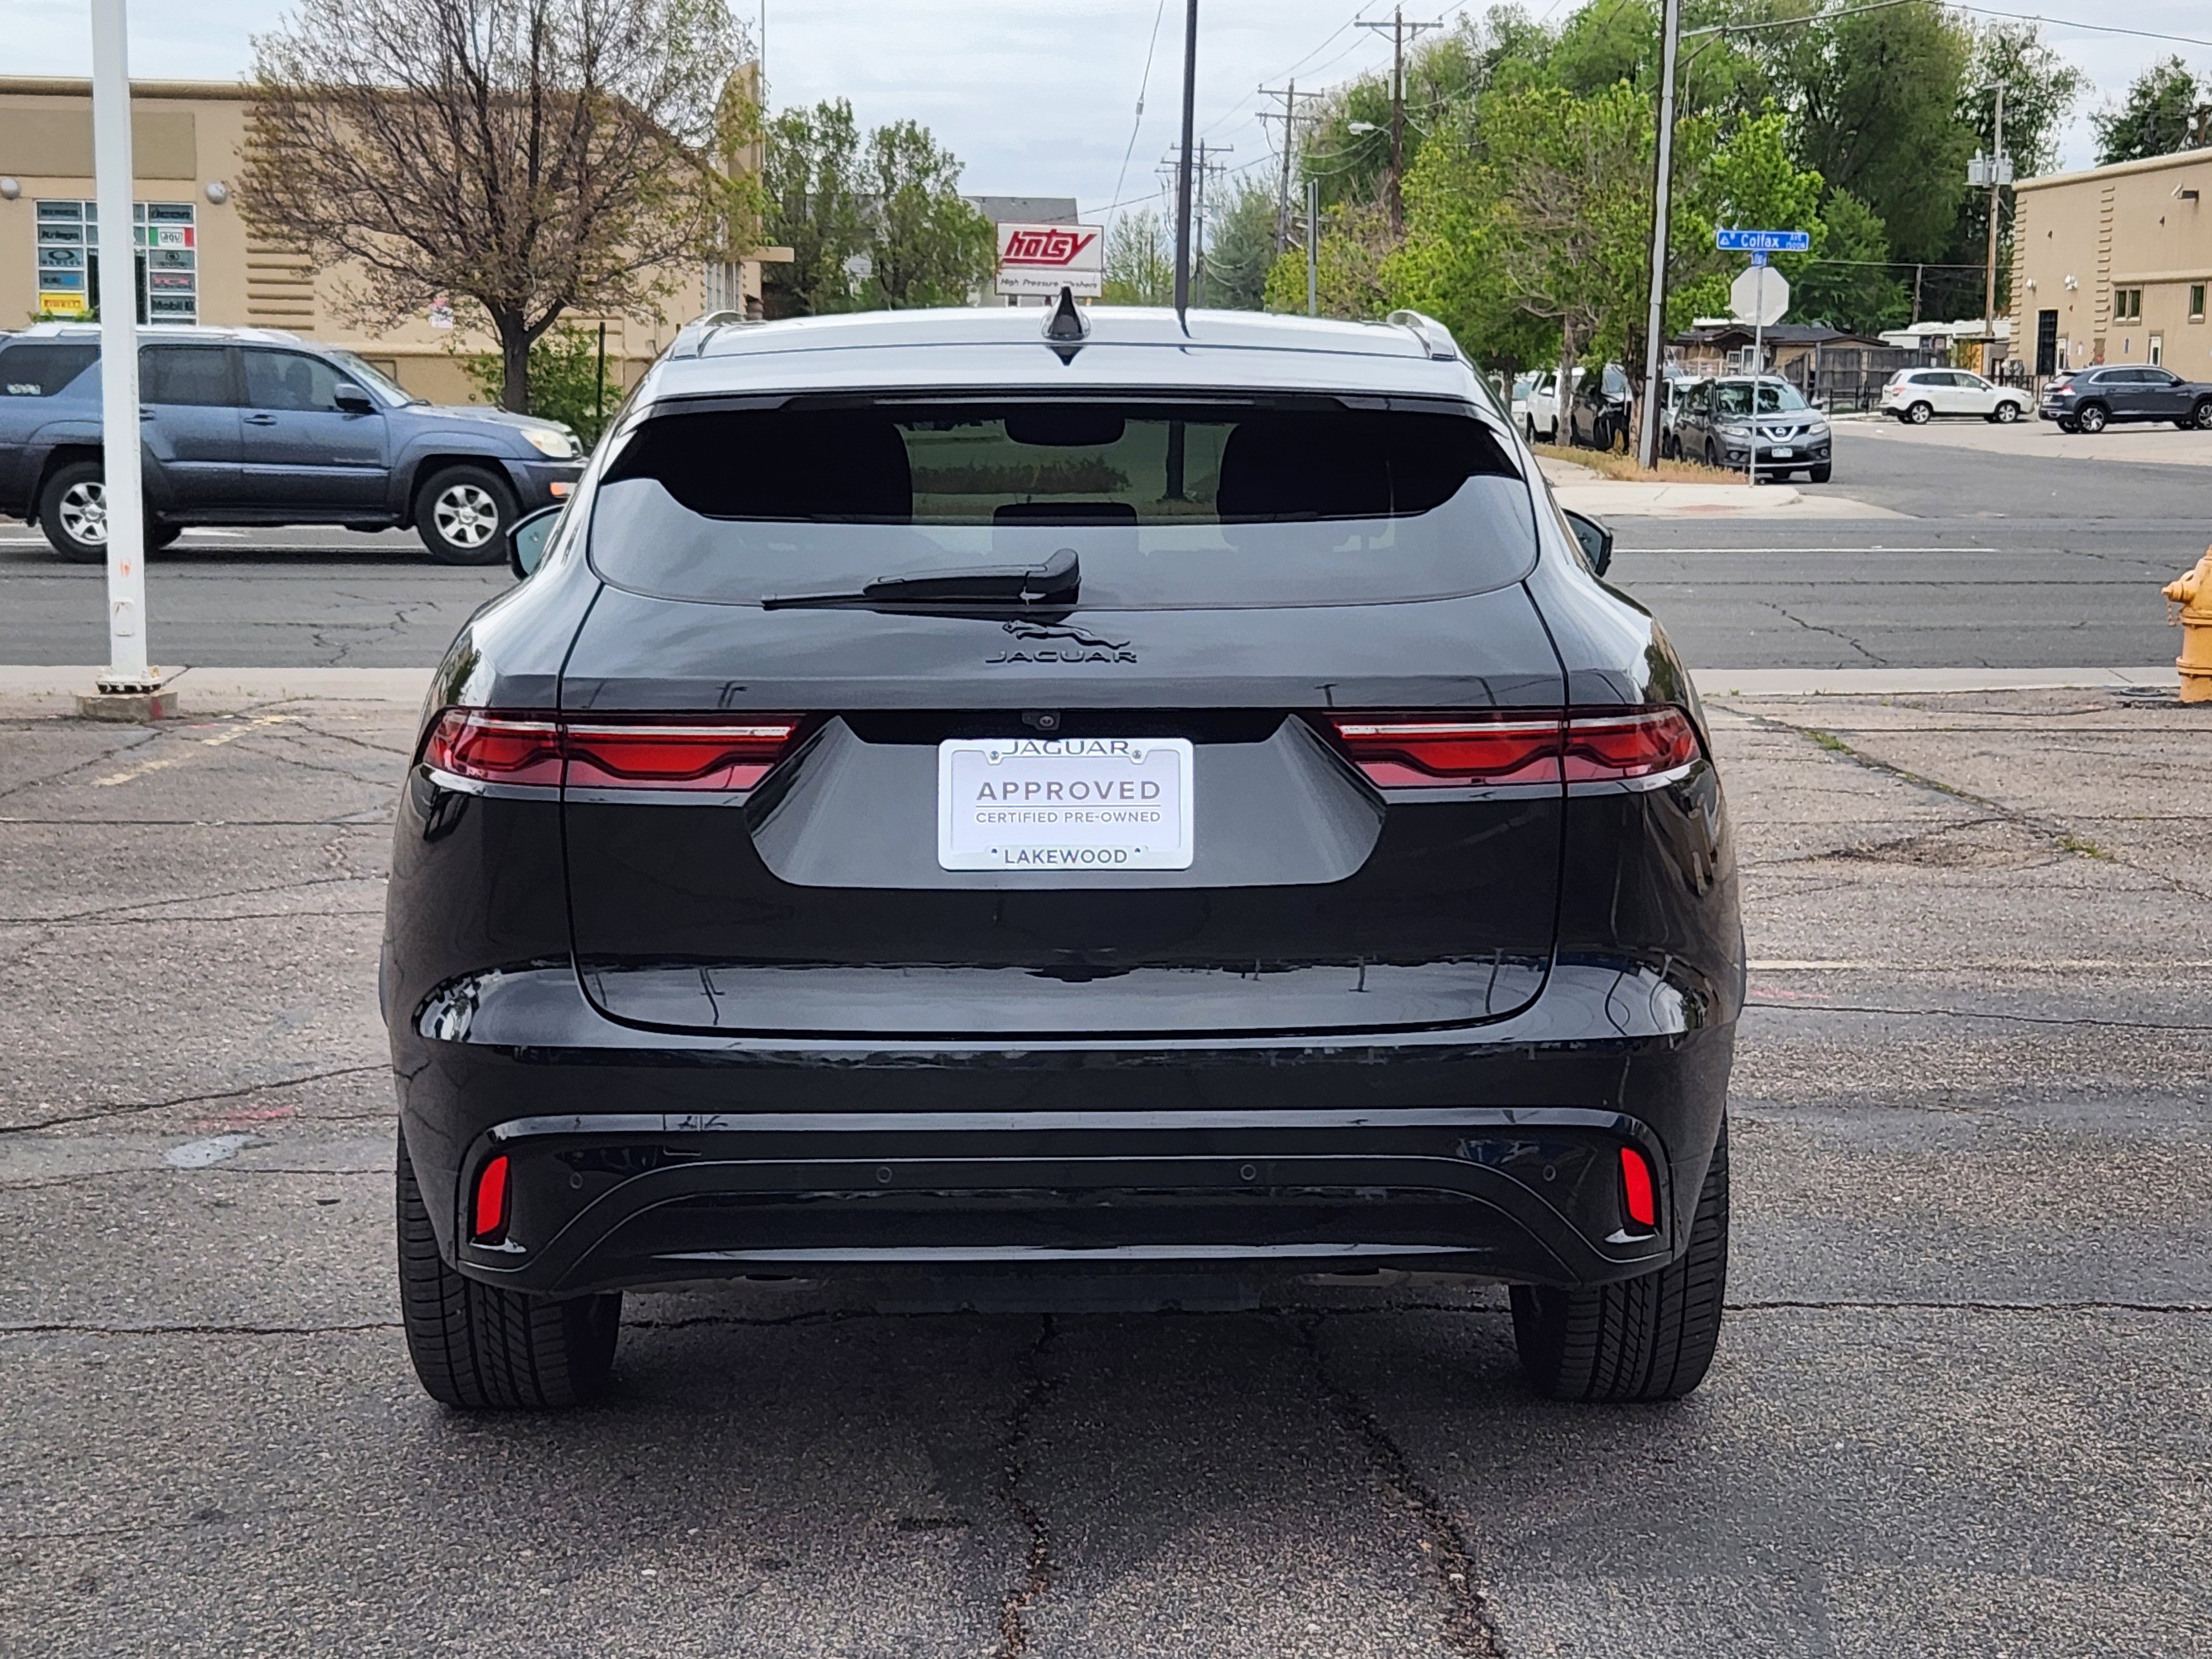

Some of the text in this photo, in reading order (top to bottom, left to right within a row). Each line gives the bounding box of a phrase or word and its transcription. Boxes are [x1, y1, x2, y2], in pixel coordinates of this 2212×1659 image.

[1741, 233, 1779, 248] Colfax
[1000, 278, 1019, 287] High
[1022, 278, 1058, 287] Pressure
[985, 650, 1137, 664] JAGUAR
[1001, 740, 1130, 755] JAGUAR
[976, 781, 1160, 800] APPROVED
[975, 811, 1161, 823] CERTIFIED PRE-OWNED
[1004, 849, 1128, 864] LAKEWOOD
